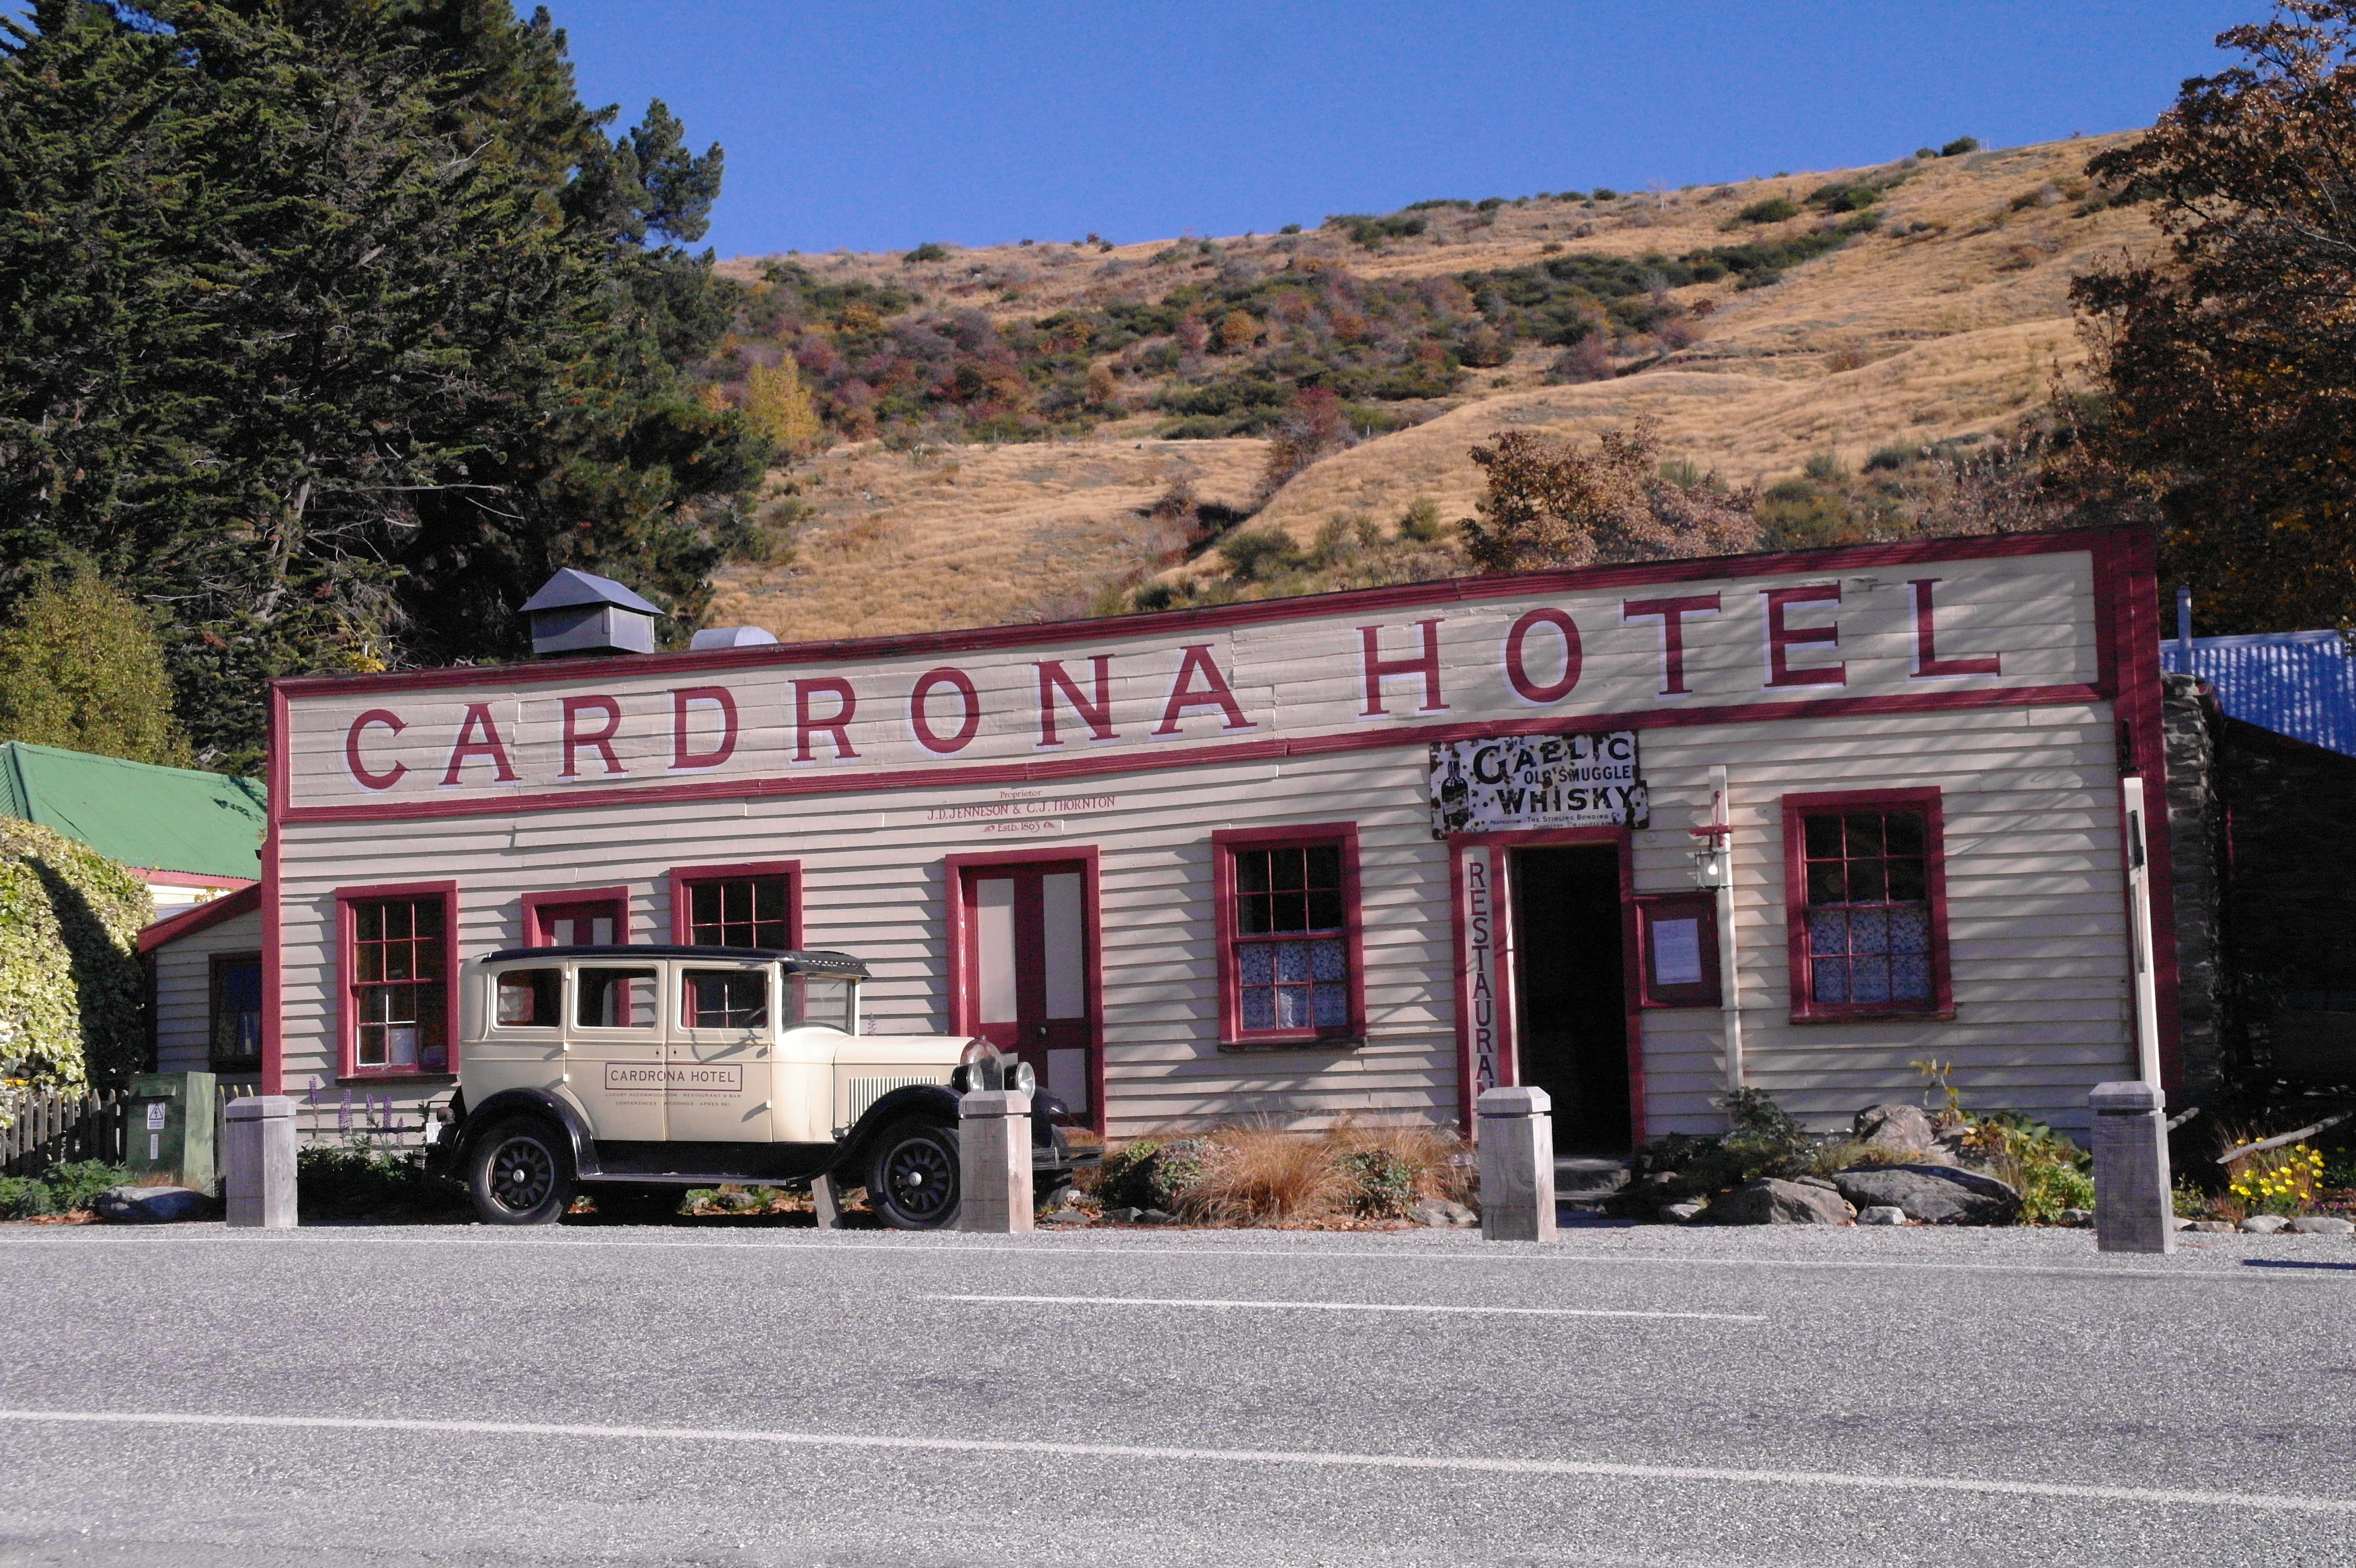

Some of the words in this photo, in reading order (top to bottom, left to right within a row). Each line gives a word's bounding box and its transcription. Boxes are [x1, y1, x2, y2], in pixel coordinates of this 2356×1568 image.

[345, 643, 1258, 790] CARDRONA
[1355, 578, 2001, 717] HOTEL
[1473, 737, 1632, 785] GAELIC
[1000, 789, 1042, 800] Proprietor
[1012, 803, 1021, 814] &
[1053, 796, 1115, 812] THORNTON
[1495, 786, 1634, 814] WHISKY
[997, 822, 1019, 832] Estb.
[1021, 821, 1040, 832] 1863
[1468, 862, 1494, 1097] RESTAURA
[611, 1070, 685, 1082] CARDRONA
[691, 1071, 735, 1083] HOTEL
